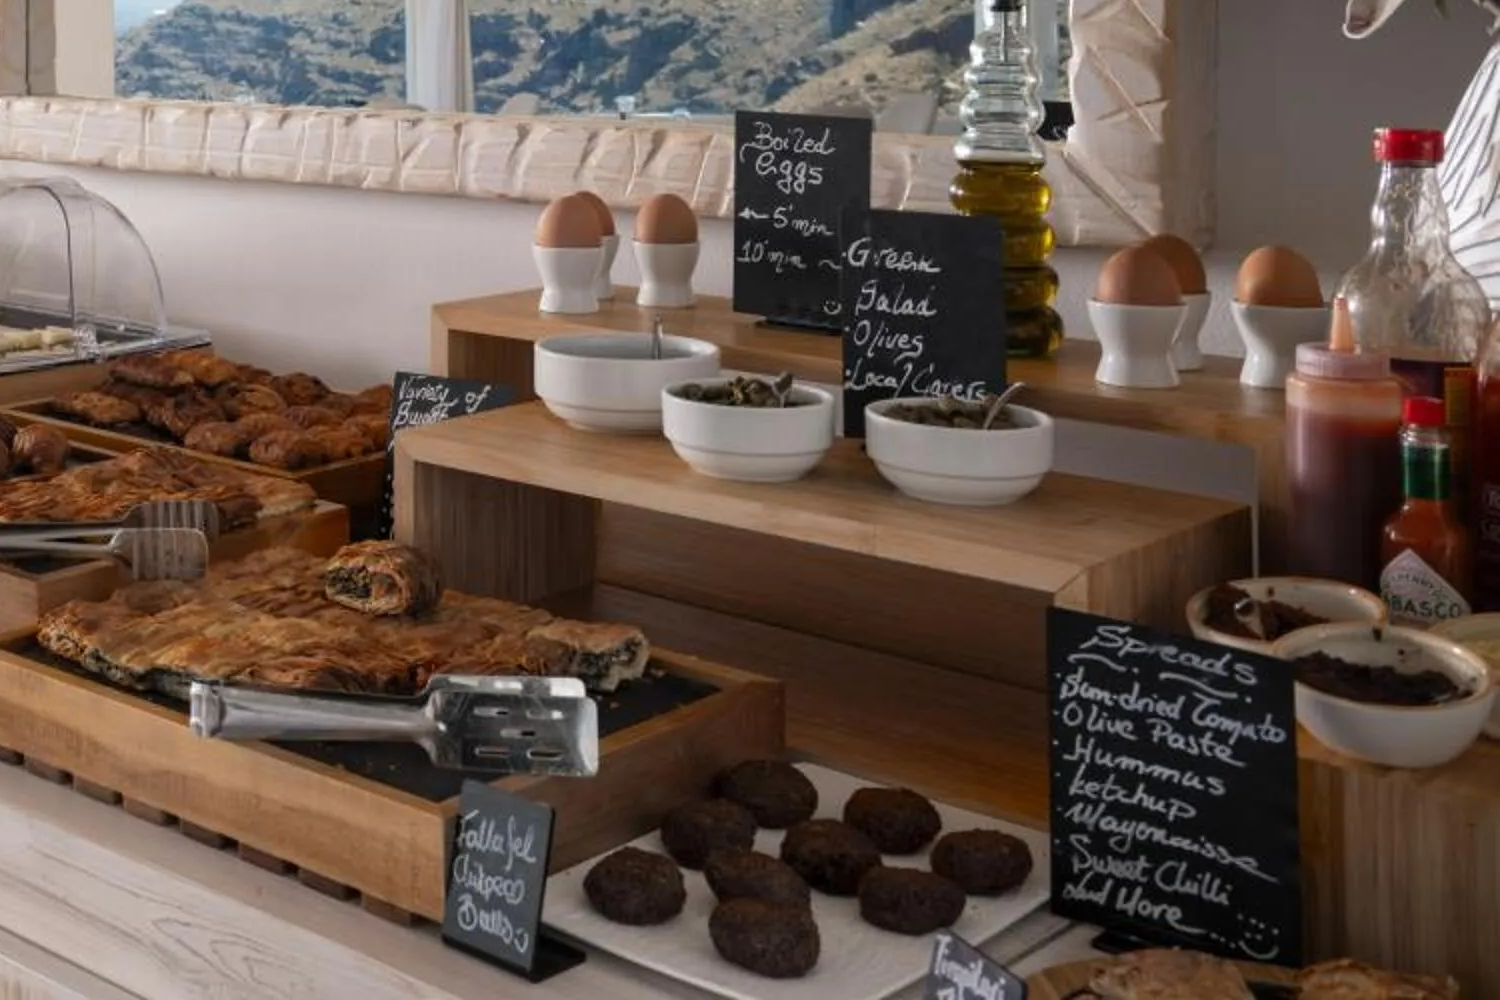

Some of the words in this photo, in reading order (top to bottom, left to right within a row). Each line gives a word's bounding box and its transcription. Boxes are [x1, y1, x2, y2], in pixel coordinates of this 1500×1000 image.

[740, 121, 836, 162] Boiled
[855, 279, 938, 318] Salad
[853, 319, 925, 365] Olives
[464, 384, 492, 414] of
[847, 357, 913, 400] Local
[1382, 594, 1461, 620] BASCO
[1078, 624, 1258, 686] Spreads
[1062, 701, 1138, 742] Olive
[1146, 717, 1246, 768] Paste
[1191, 692, 1288, 746] Tomato
[1062, 732, 1227, 796] Hummus
[1069, 833, 1152, 883] Sweet
[1154, 860, 1233, 906] Chilli
